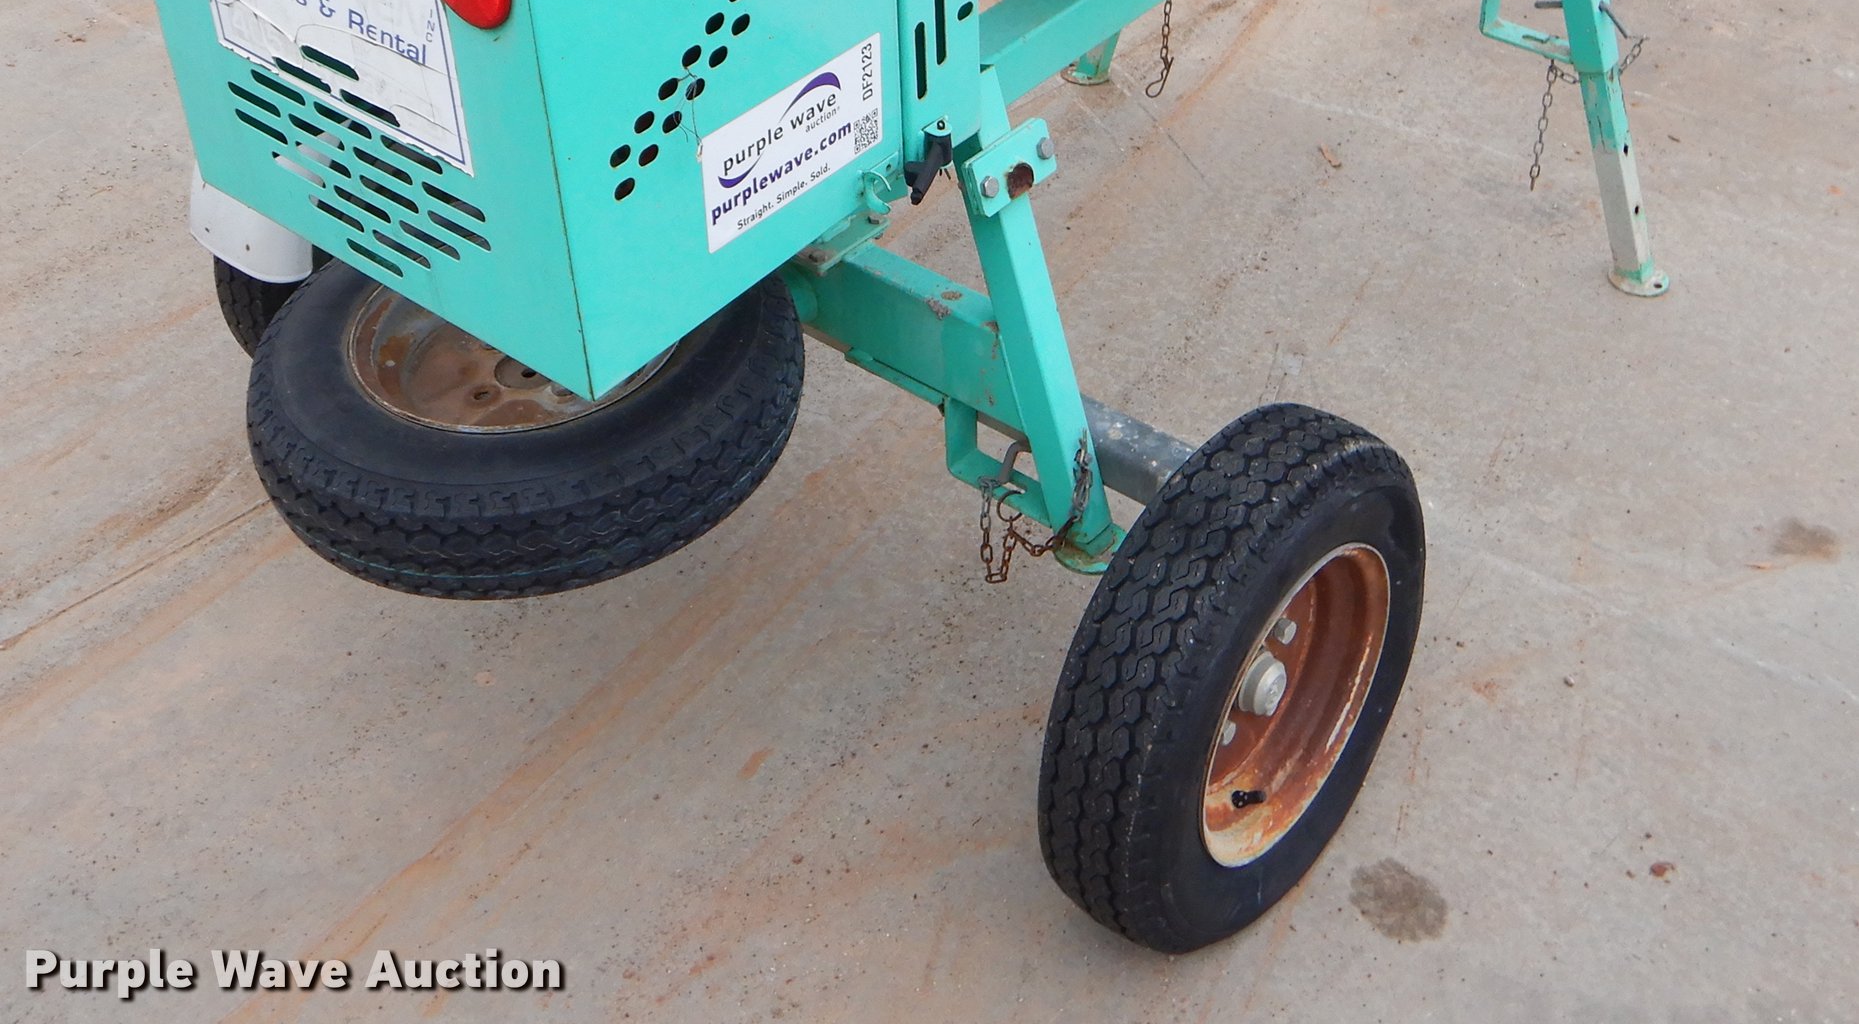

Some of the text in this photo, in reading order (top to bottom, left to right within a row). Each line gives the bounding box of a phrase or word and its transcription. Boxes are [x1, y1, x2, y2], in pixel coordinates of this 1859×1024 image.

[348, 9, 427, 65] Rental
[861, 42, 873, 101] DF2123
[723, 93, 837, 176] purple wave
[711, 122, 853, 226] purplewave.com
[737, 163, 831, 230] Straight. Simple. Sold.
